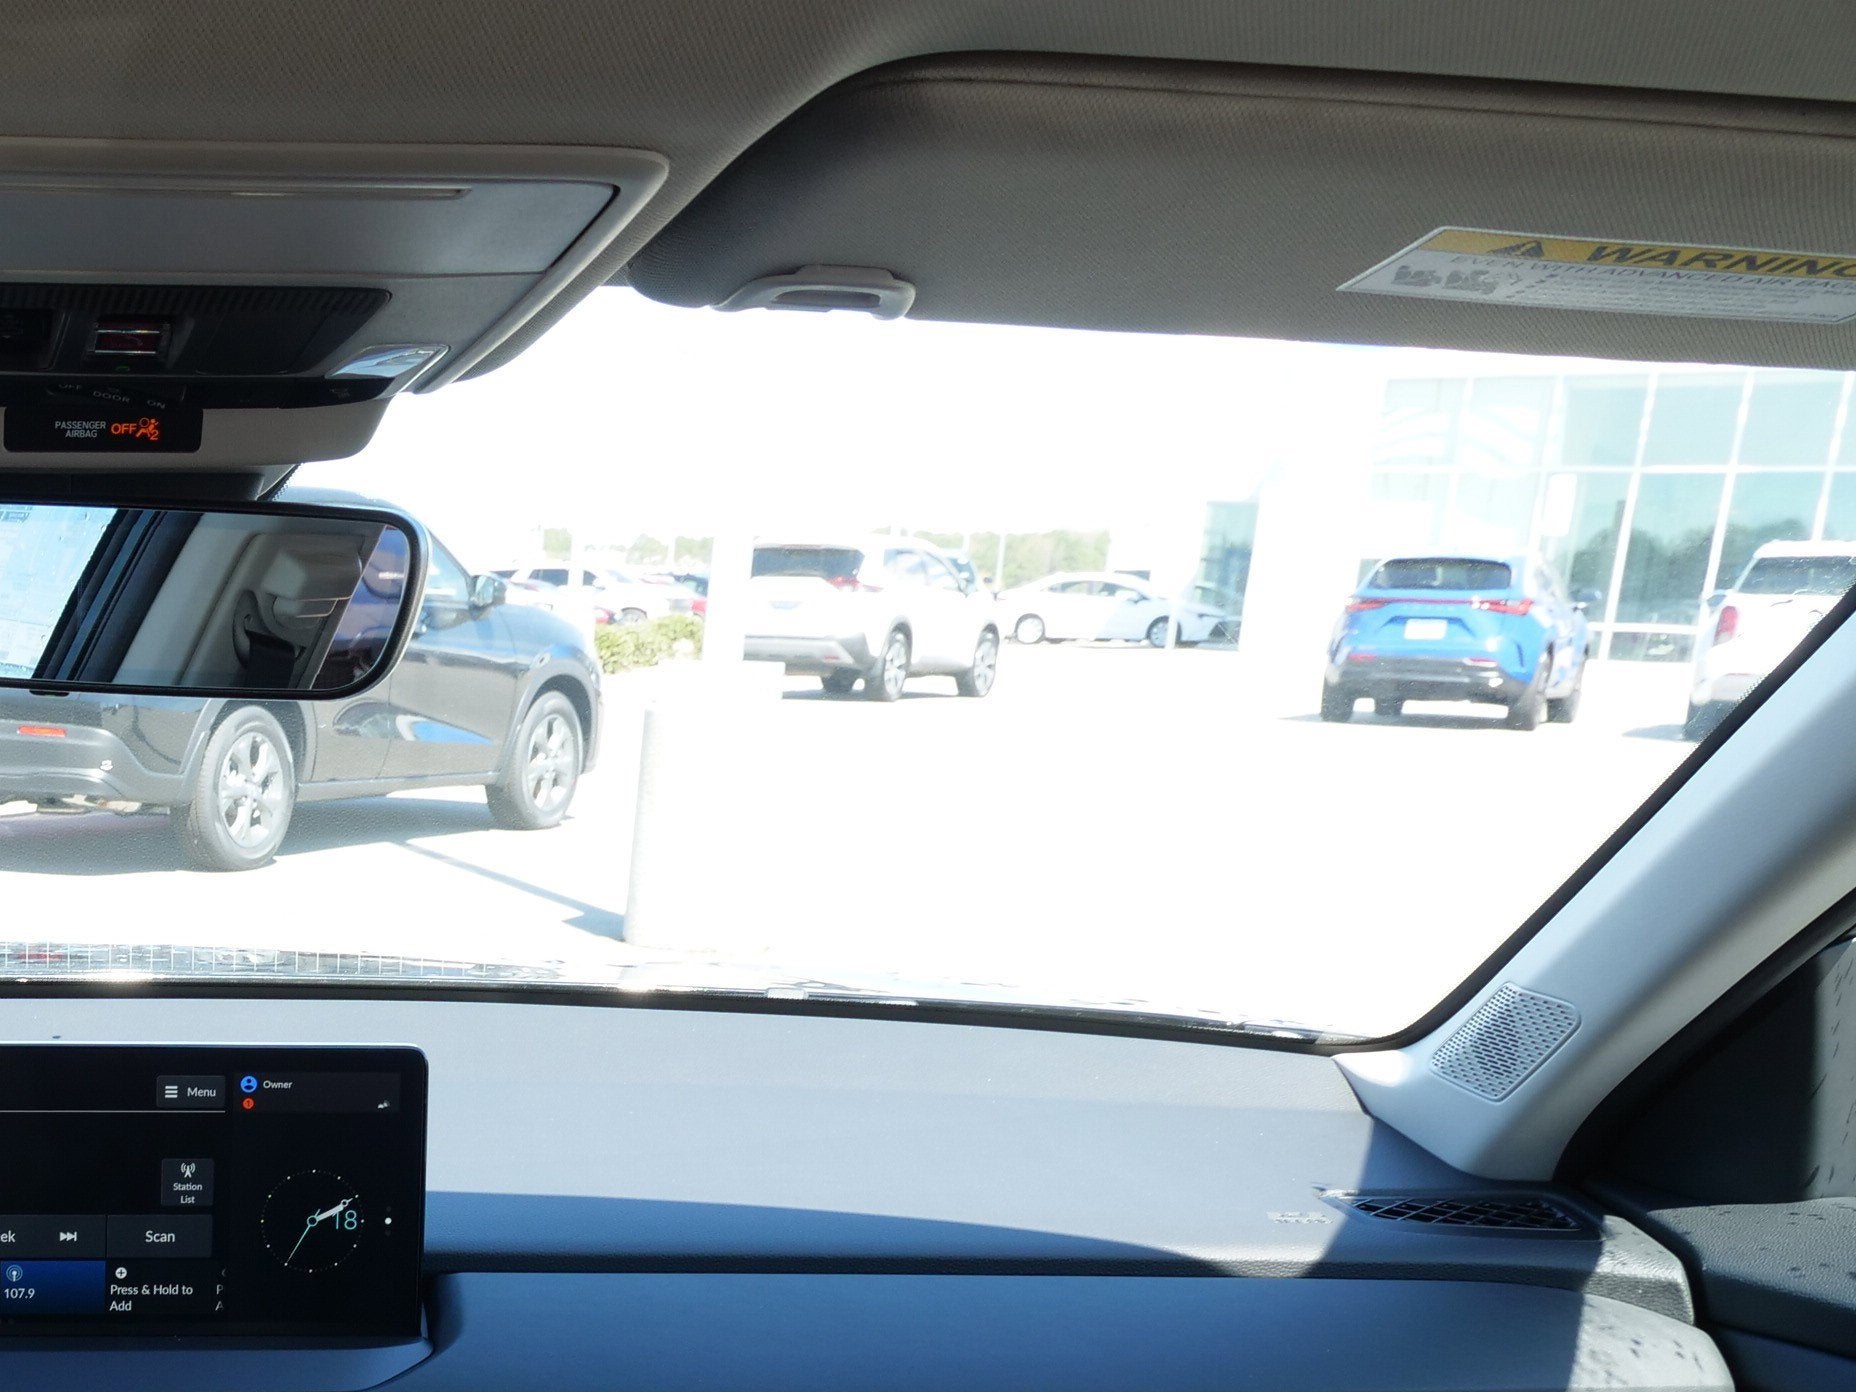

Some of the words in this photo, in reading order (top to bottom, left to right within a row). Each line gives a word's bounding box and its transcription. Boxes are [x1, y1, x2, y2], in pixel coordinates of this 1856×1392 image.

[92, 390, 130, 403] DOOR
[55, 420, 106, 429] PASSENGER
[111, 423, 137, 434] OFF
[65, 430, 98, 438] AIRBAG
[263, 1080, 293, 1089] Owner
[187, 1087, 217, 1097] Menu
[173, 1182, 203, 1191] Station
[180, 1195, 195, 1204] List
[334, 1210, 358, 1230] 18
[145, 1230, 176, 1243] Scan
[4, 1288, 35, 1299] 107.9
[110, 1284, 139, 1295] Press
[141, 1284, 150, 1295] &
[153, 1284, 179, 1295] Hold
[182, 1285, 193, 1295] to
[109, 1300, 132, 1311] Add
